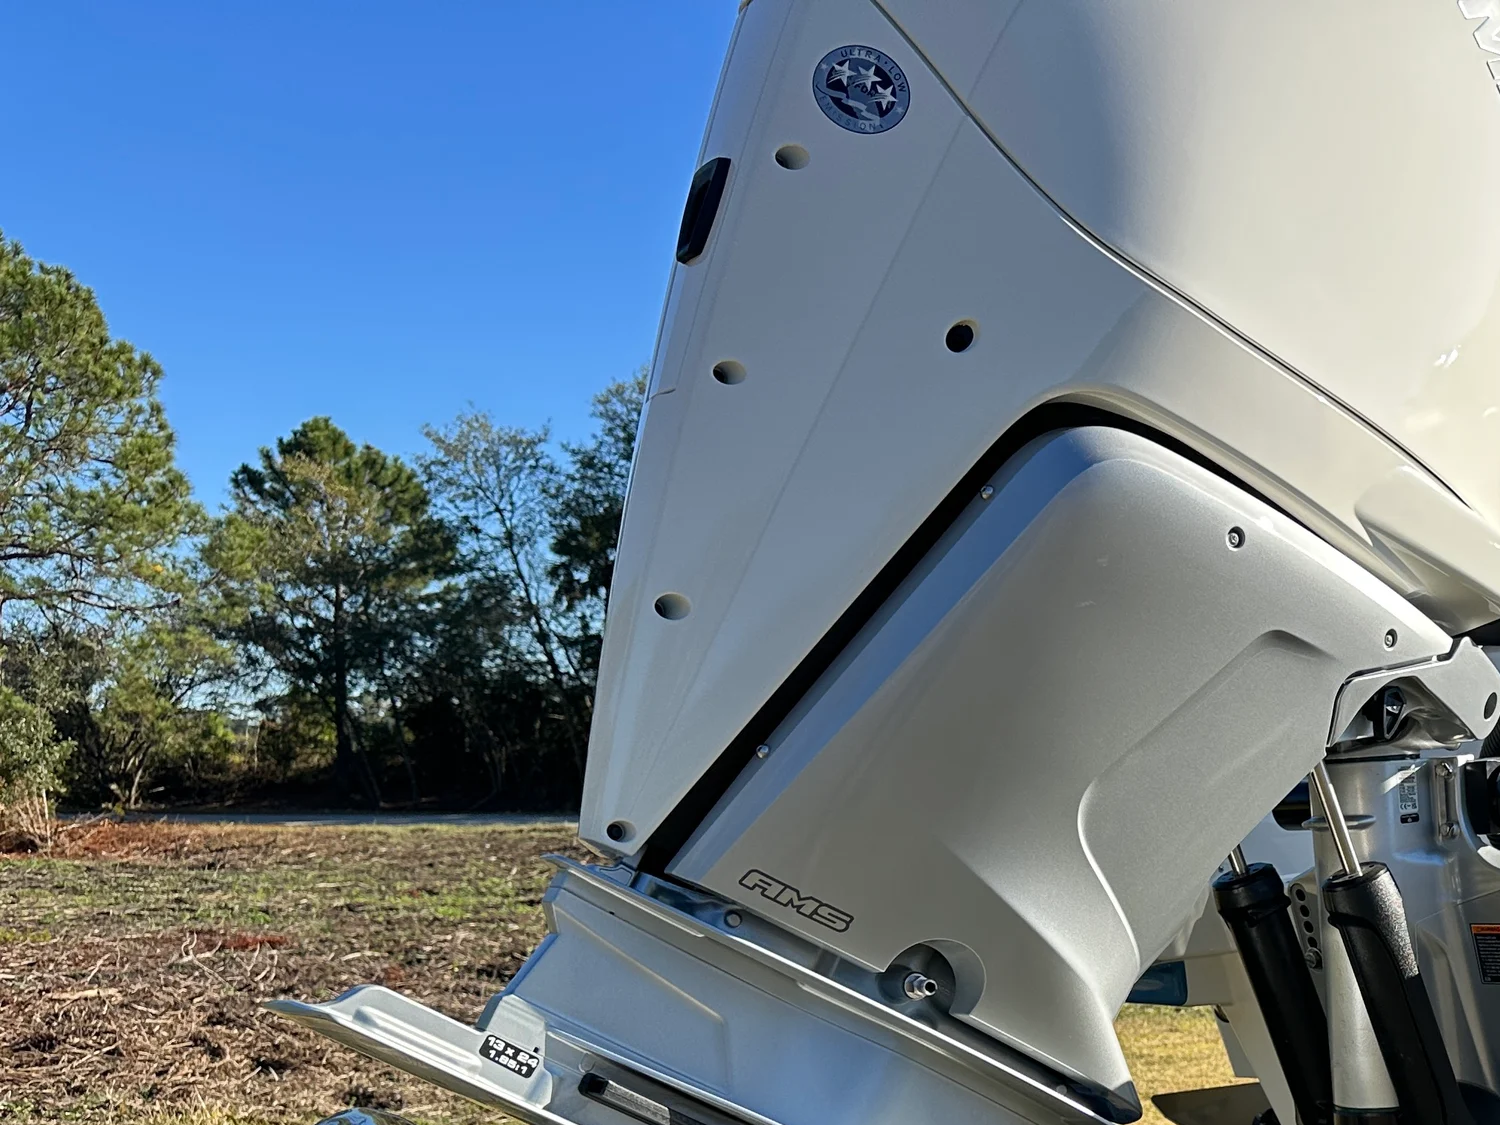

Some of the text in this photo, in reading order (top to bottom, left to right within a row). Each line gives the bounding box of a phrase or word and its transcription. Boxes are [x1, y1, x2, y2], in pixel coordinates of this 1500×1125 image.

[840, 48, 881, 63] ULTRA
[888, 65, 906, 94] LOW
[739, 869, 854, 932] AMS
[488, 1037, 506, 1051] 13
[517, 1051, 538, 1068] 24
[489, 1049, 528, 1074] 1.85:1
